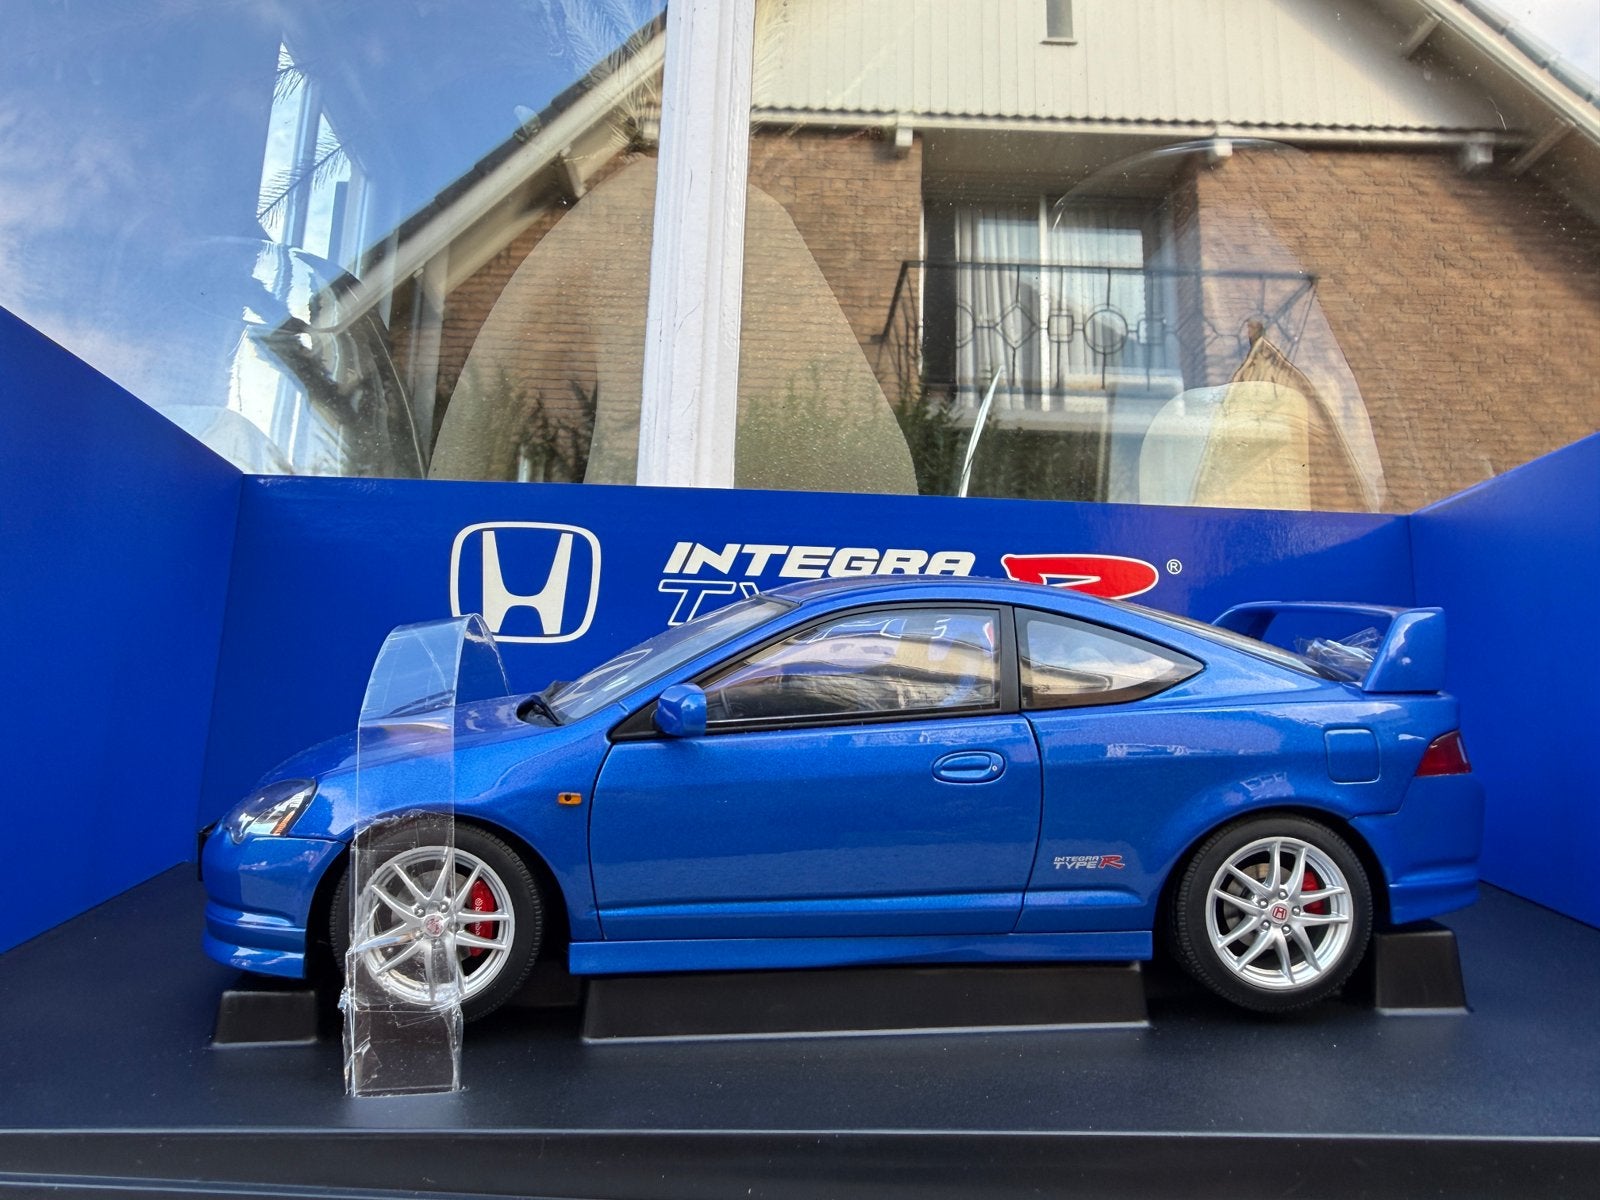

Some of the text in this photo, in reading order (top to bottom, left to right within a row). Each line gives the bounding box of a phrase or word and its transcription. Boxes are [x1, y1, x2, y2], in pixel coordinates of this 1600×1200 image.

[663, 541, 976, 578] INTEGRA
[1053, 854, 1126, 869] TYPE R
